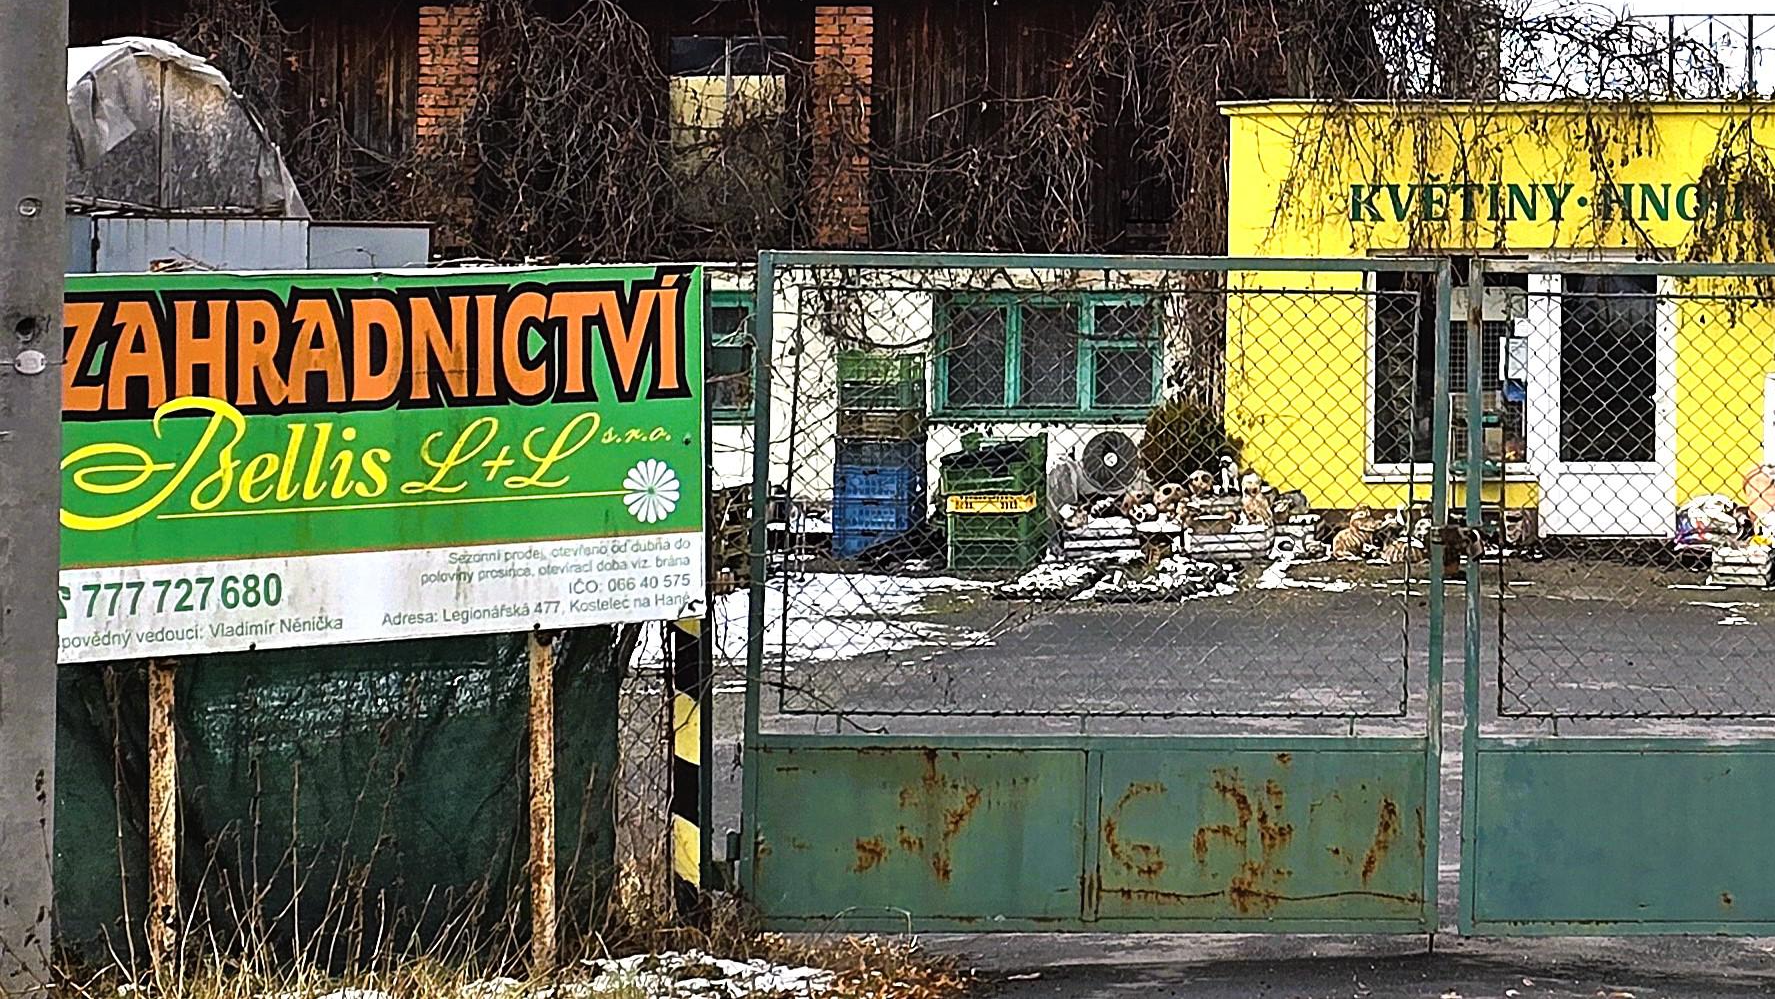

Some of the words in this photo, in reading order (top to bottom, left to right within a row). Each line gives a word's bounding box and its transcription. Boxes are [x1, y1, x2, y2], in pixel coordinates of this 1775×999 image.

[1350, 176, 1575, 221] KVĚTINY
[63, 274, 678, 410] ZAHRADNICTVÍ
[60, 396, 390, 530] Bellis
[611, 541, 628, 554] od
[631, 539, 671, 554] dubna
[674, 537, 691, 550] do
[420, 569, 474, 586] poloviny
[597, 559, 628, 572] doba
[656, 554, 691, 568] brána
[569, 578, 602, 595] IČO:
[608, 576, 636, 592] 066
[640, 575, 659, 589] 40
[663, 573, 691, 588] 575
[82, 581, 145, 618] 777
[153, 577, 215, 614] 727
[221, 572, 282, 610] 680
[382, 611, 438, 626] Adresa:
[633, 596, 651, 609] na
[209, 617, 275, 639] Vladimír
